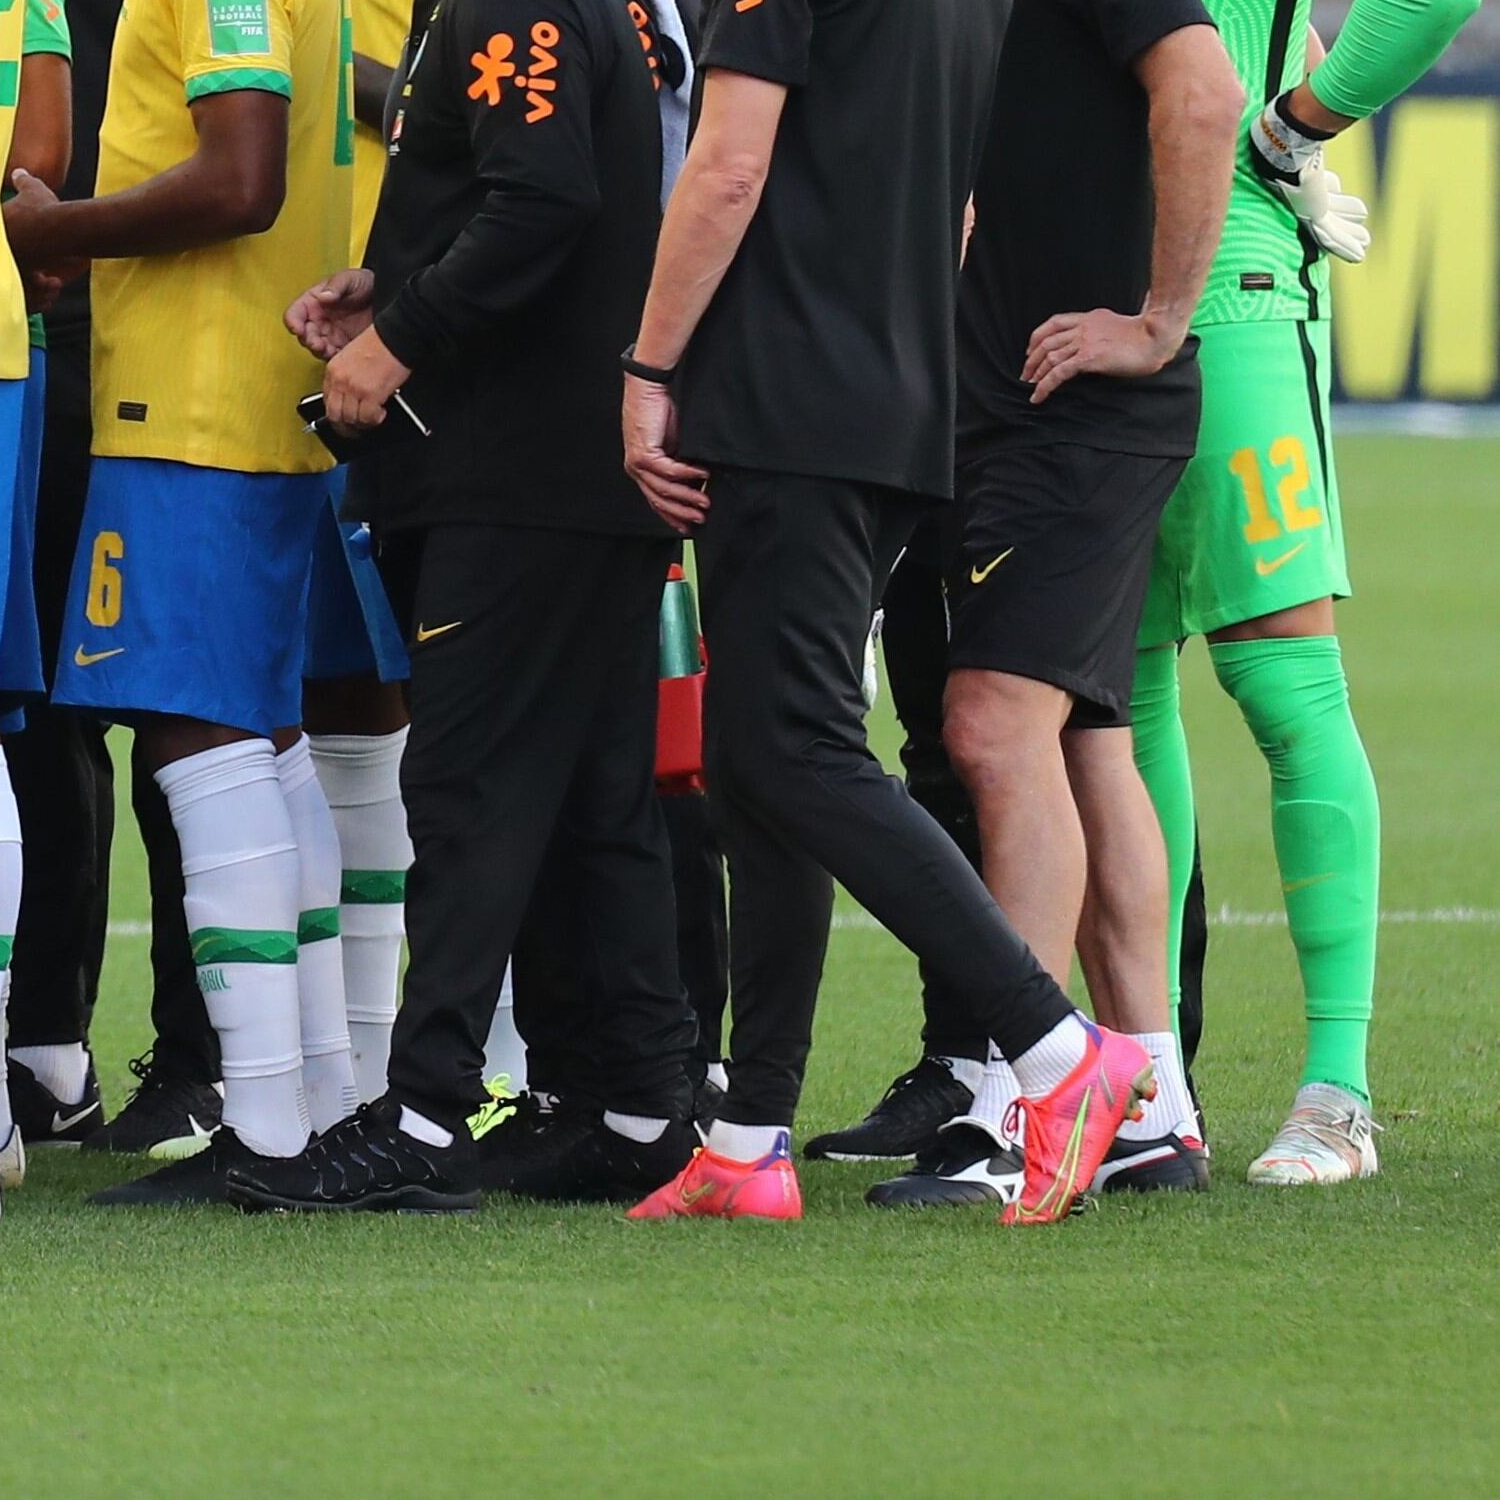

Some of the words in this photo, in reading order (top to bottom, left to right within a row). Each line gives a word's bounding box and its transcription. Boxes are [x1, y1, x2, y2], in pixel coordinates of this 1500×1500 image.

[241, 26, 265, 36] FIFA
[514, 21, 560, 124] vivo
[1229, 436, 1322, 543] 12
[86, 531, 123, 627] 6
